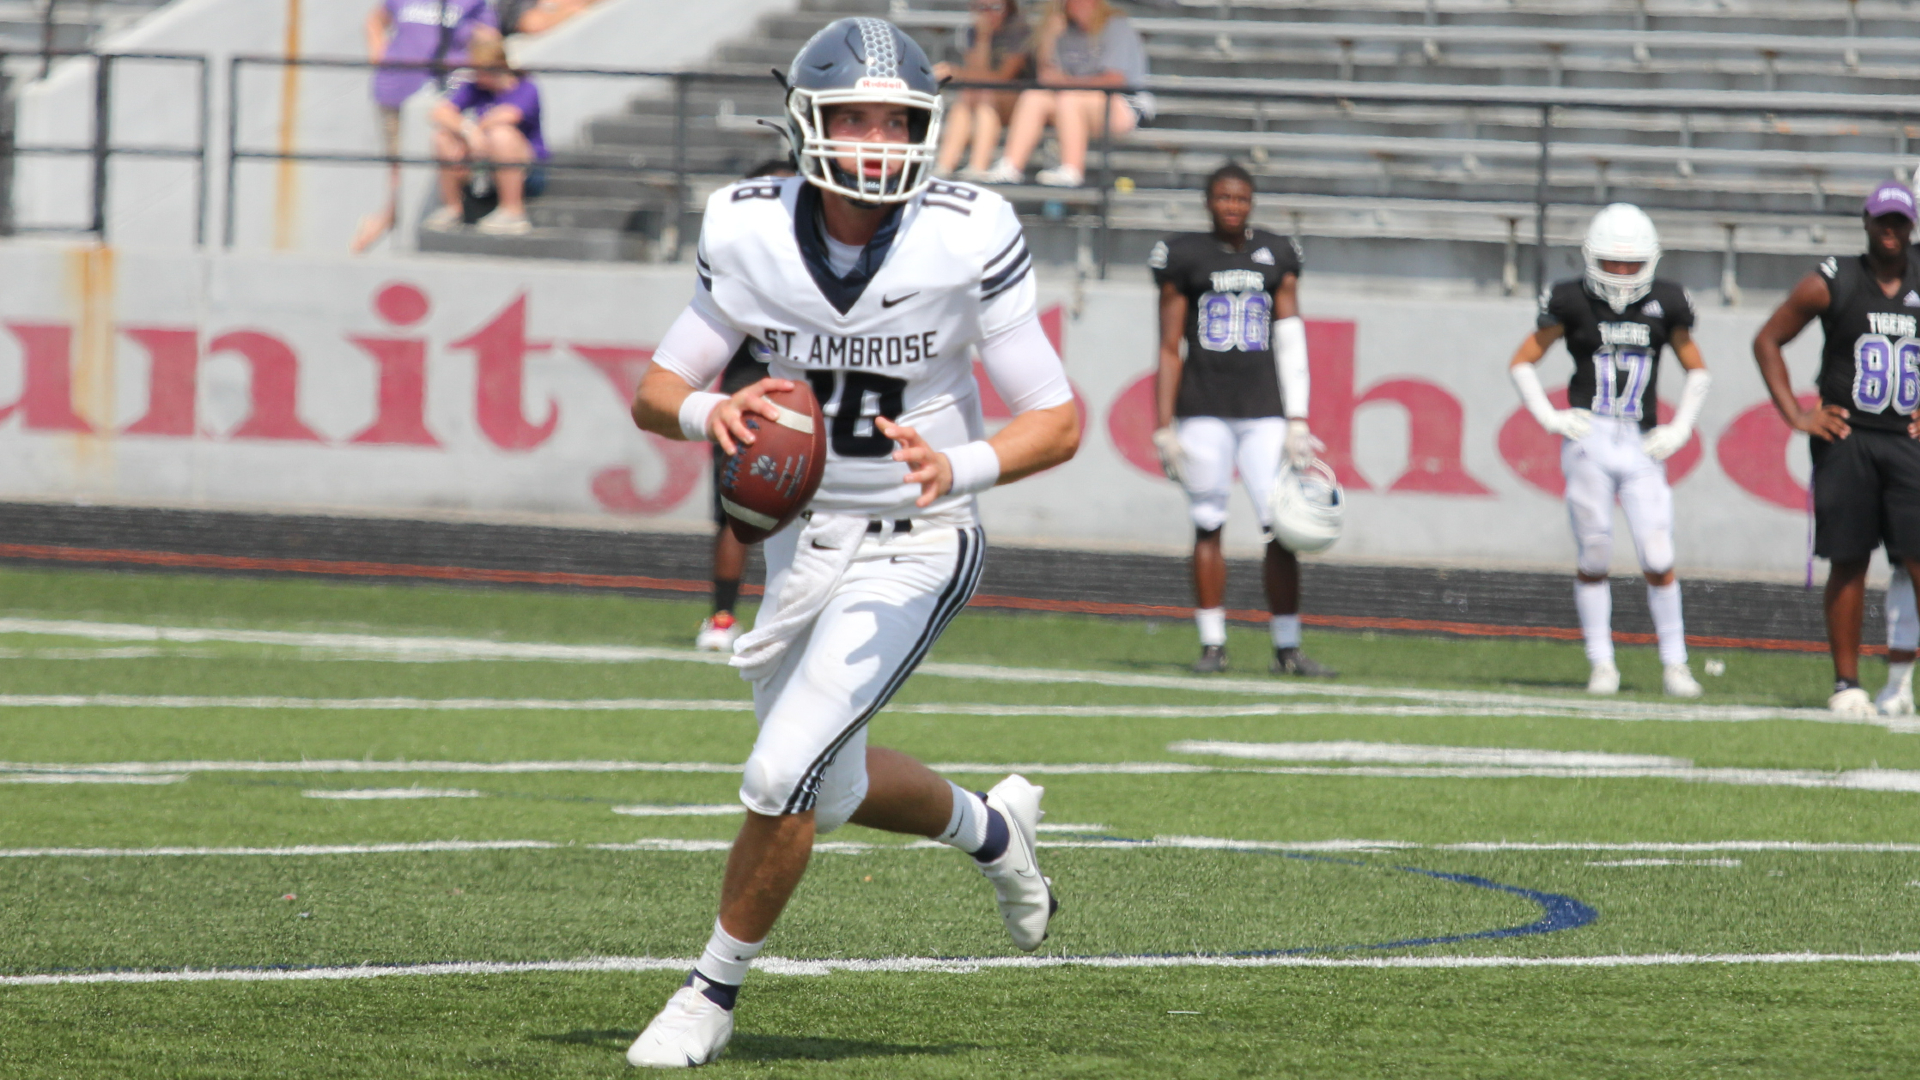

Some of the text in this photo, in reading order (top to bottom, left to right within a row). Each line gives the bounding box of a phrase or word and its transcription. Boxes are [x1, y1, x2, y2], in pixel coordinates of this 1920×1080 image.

[764, 328, 938, 367] ST. AMBROSE
[1867, 311, 1917, 338] TIGERS
[1592, 344, 1655, 421] 17
[1852, 332, 1920, 416] 86
